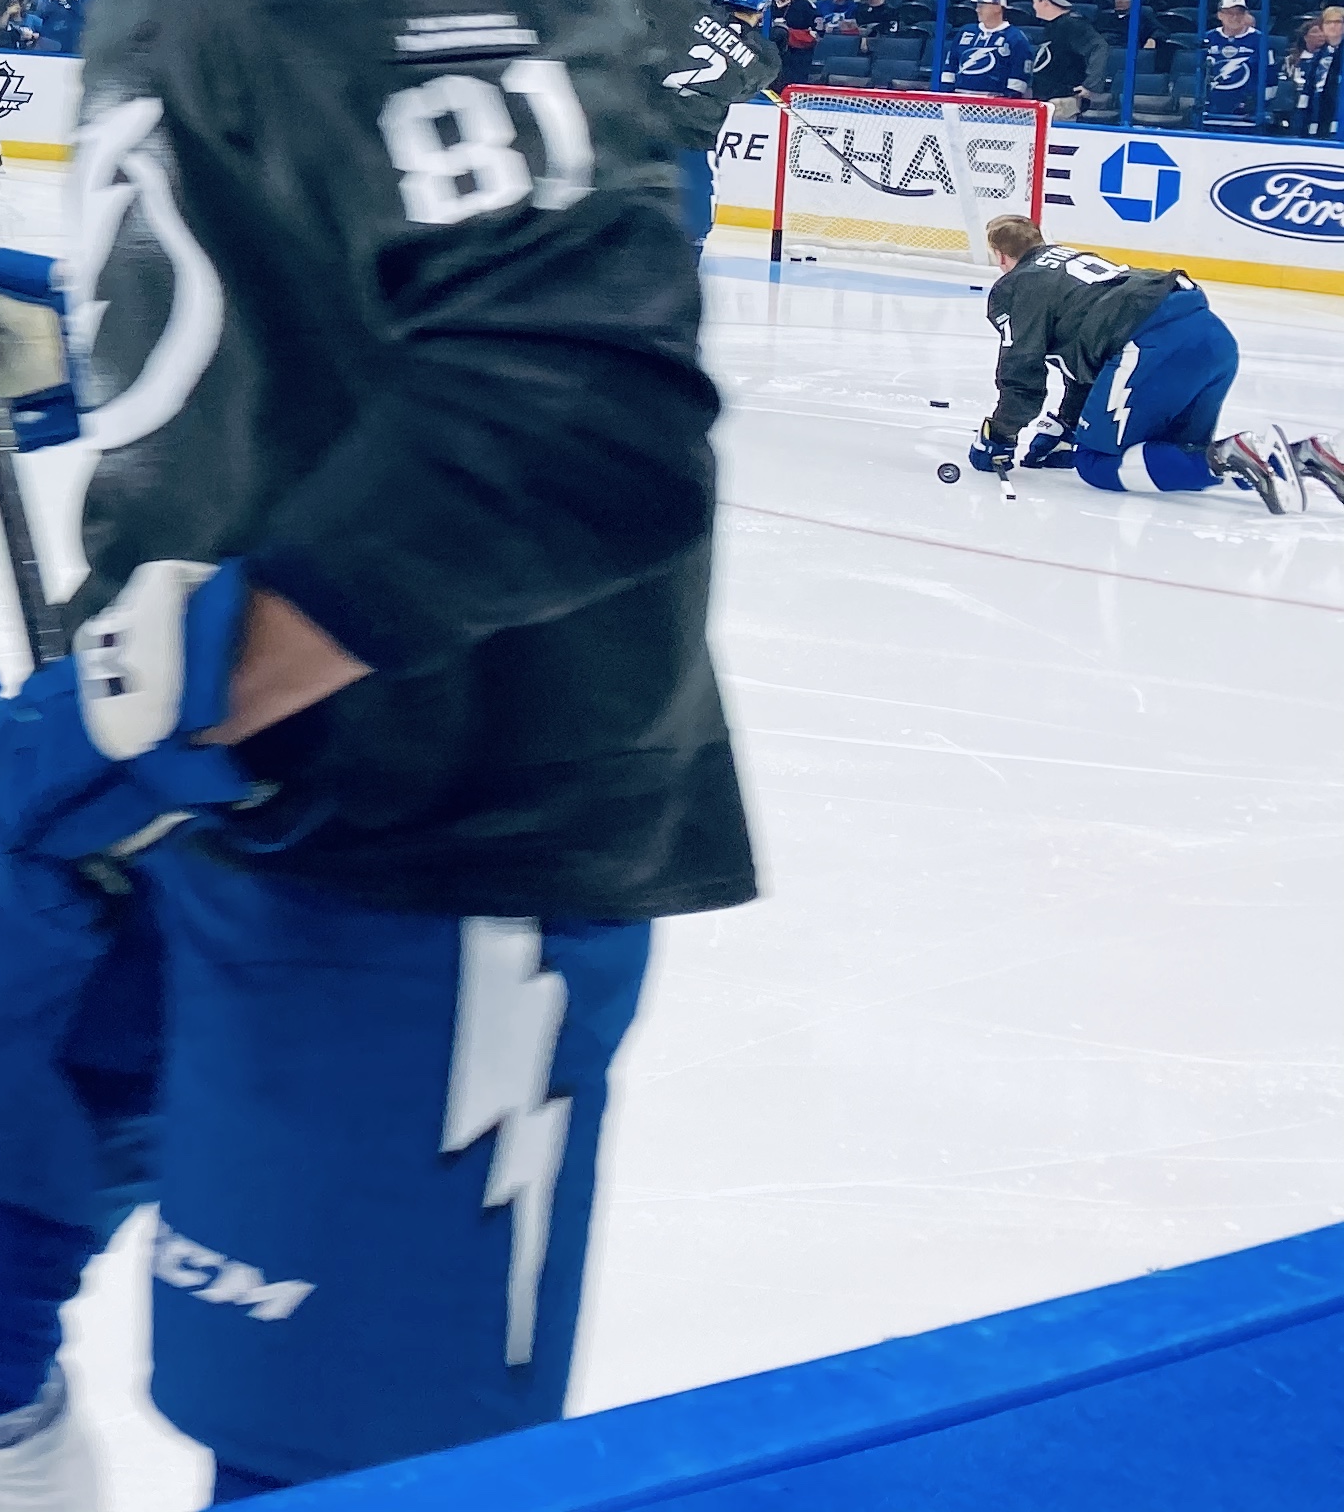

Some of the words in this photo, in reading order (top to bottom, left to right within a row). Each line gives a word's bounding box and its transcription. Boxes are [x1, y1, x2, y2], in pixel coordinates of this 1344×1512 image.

[662, 44, 729, 96] 2
[694, 15, 755, 68] SCHENN
[378, 58, 595, 227] 81
[790, 125, 1079, 206] CHASE
